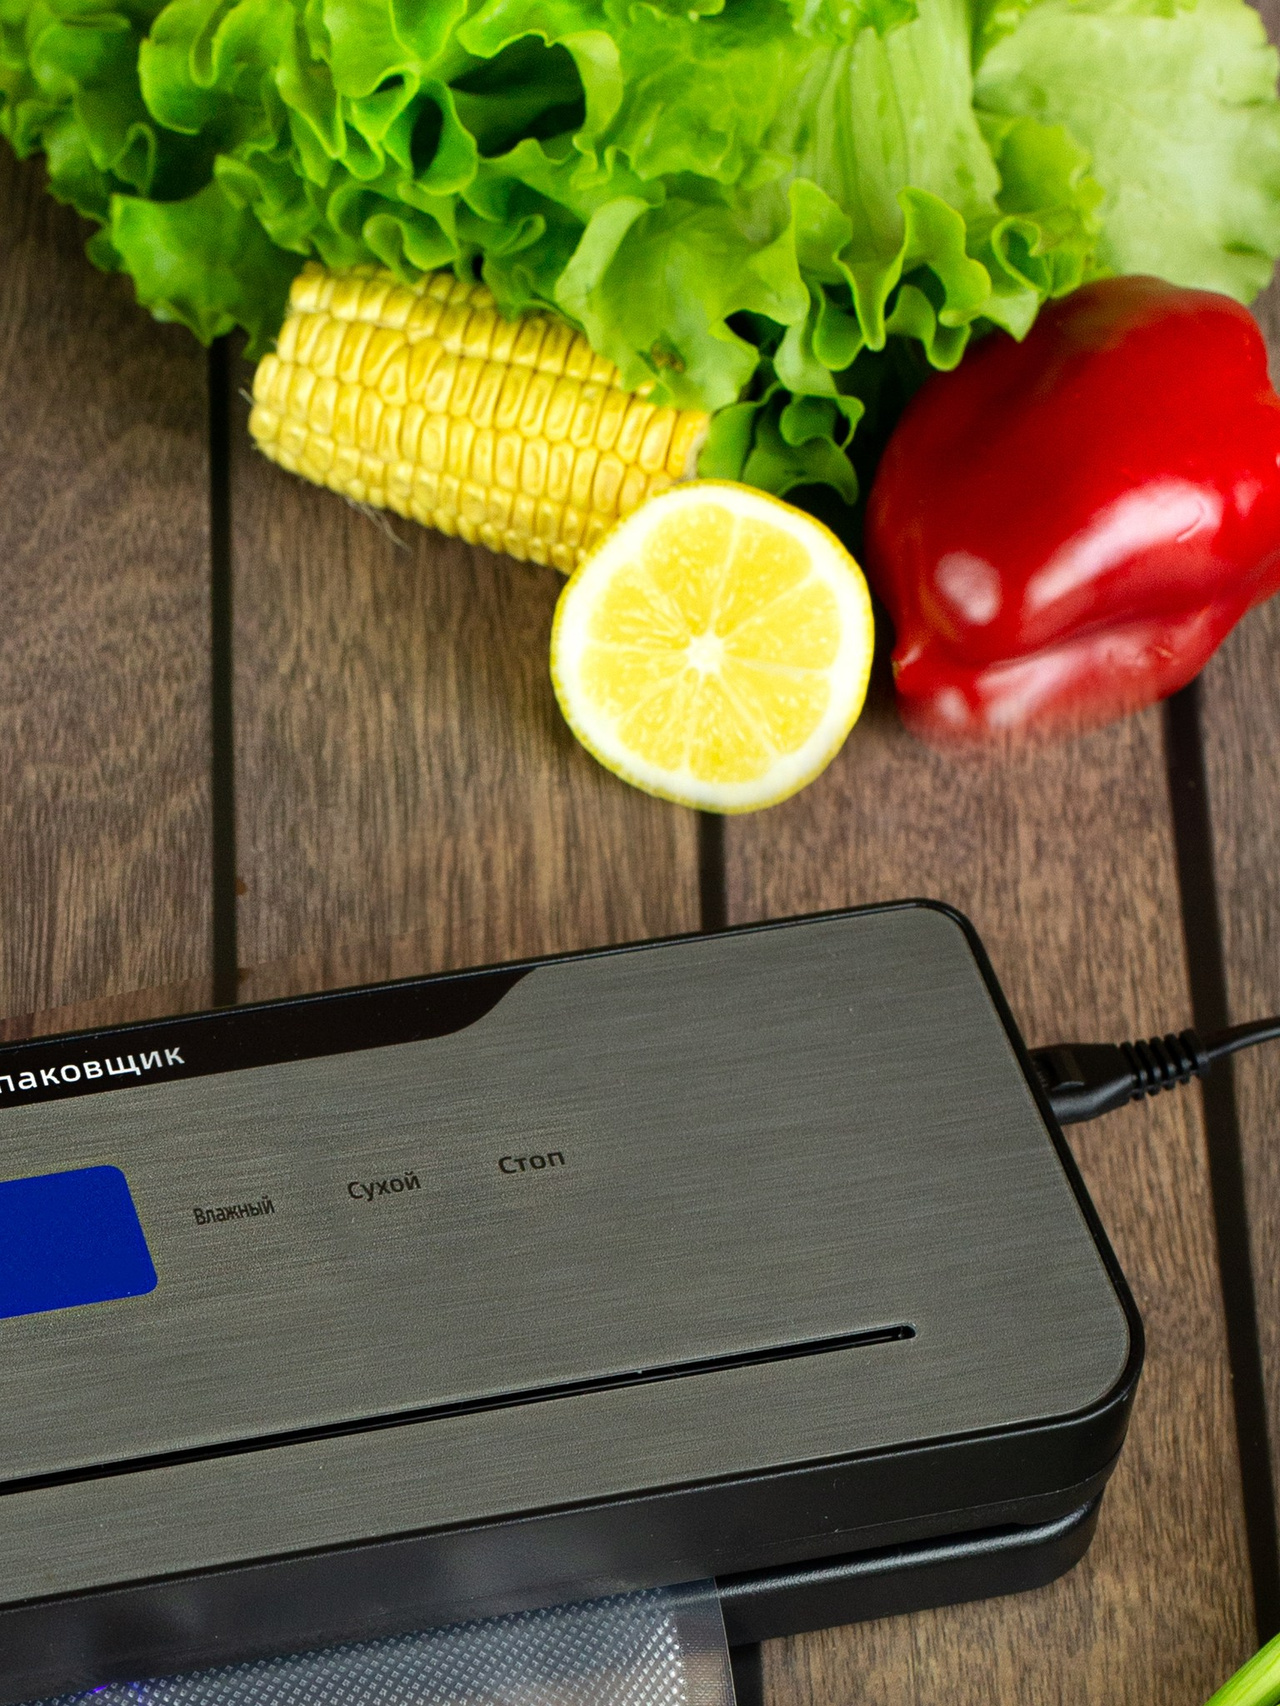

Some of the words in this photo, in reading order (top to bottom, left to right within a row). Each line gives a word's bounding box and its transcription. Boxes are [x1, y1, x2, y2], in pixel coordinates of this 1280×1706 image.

[497, 1150, 566, 1175] Стоп
[347, 1171, 421, 1202] Сухой
[192, 1194, 276, 1226] Влажный
